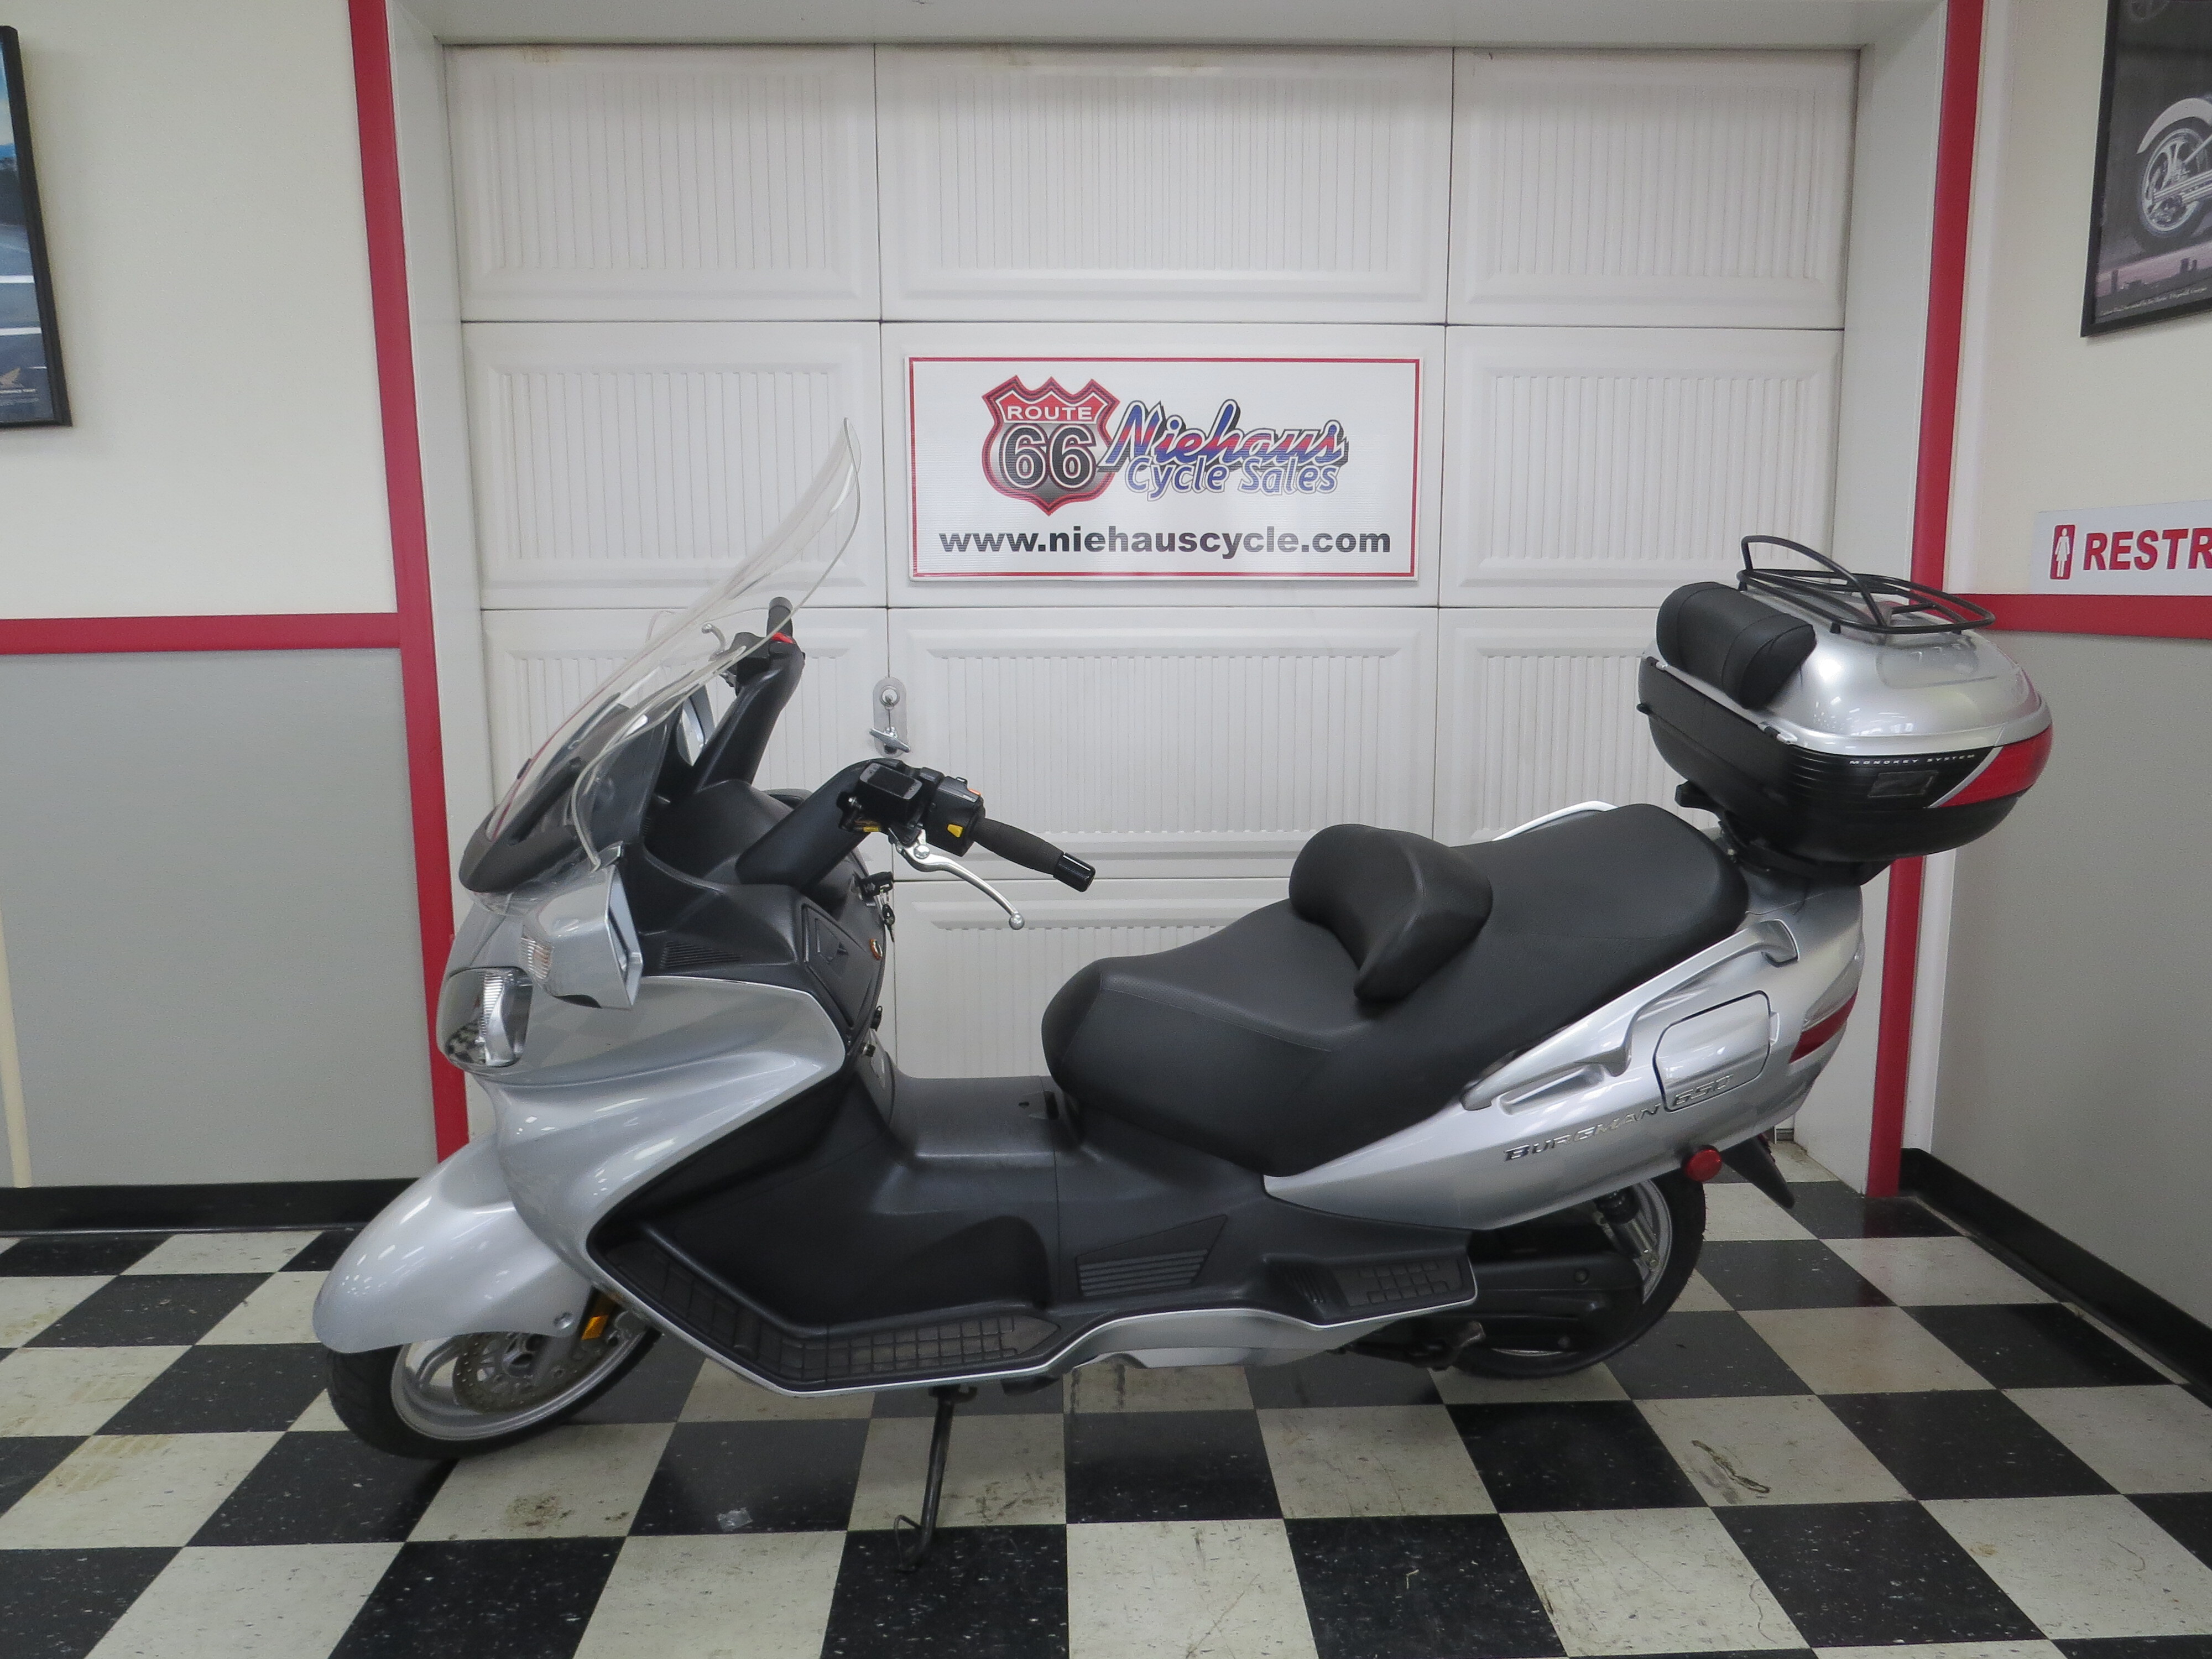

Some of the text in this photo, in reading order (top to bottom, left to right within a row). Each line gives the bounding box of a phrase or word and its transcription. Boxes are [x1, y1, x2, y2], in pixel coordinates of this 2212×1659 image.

[1006, 405, 1093, 421] ROUTE
[1099, 399, 1348, 471] Niehaus
[1001, 423, 1095, 490] 66
[1126, 455, 1341, 500] Cycle Sales
[938, 525, 1391, 559] www.niehauscycle.com
[2083, 527, 2212, 571] RESTR
[1926, 754, 1975, 763] SYSTEM
[1504, 1103, 1661, 1161] BURGMAN
